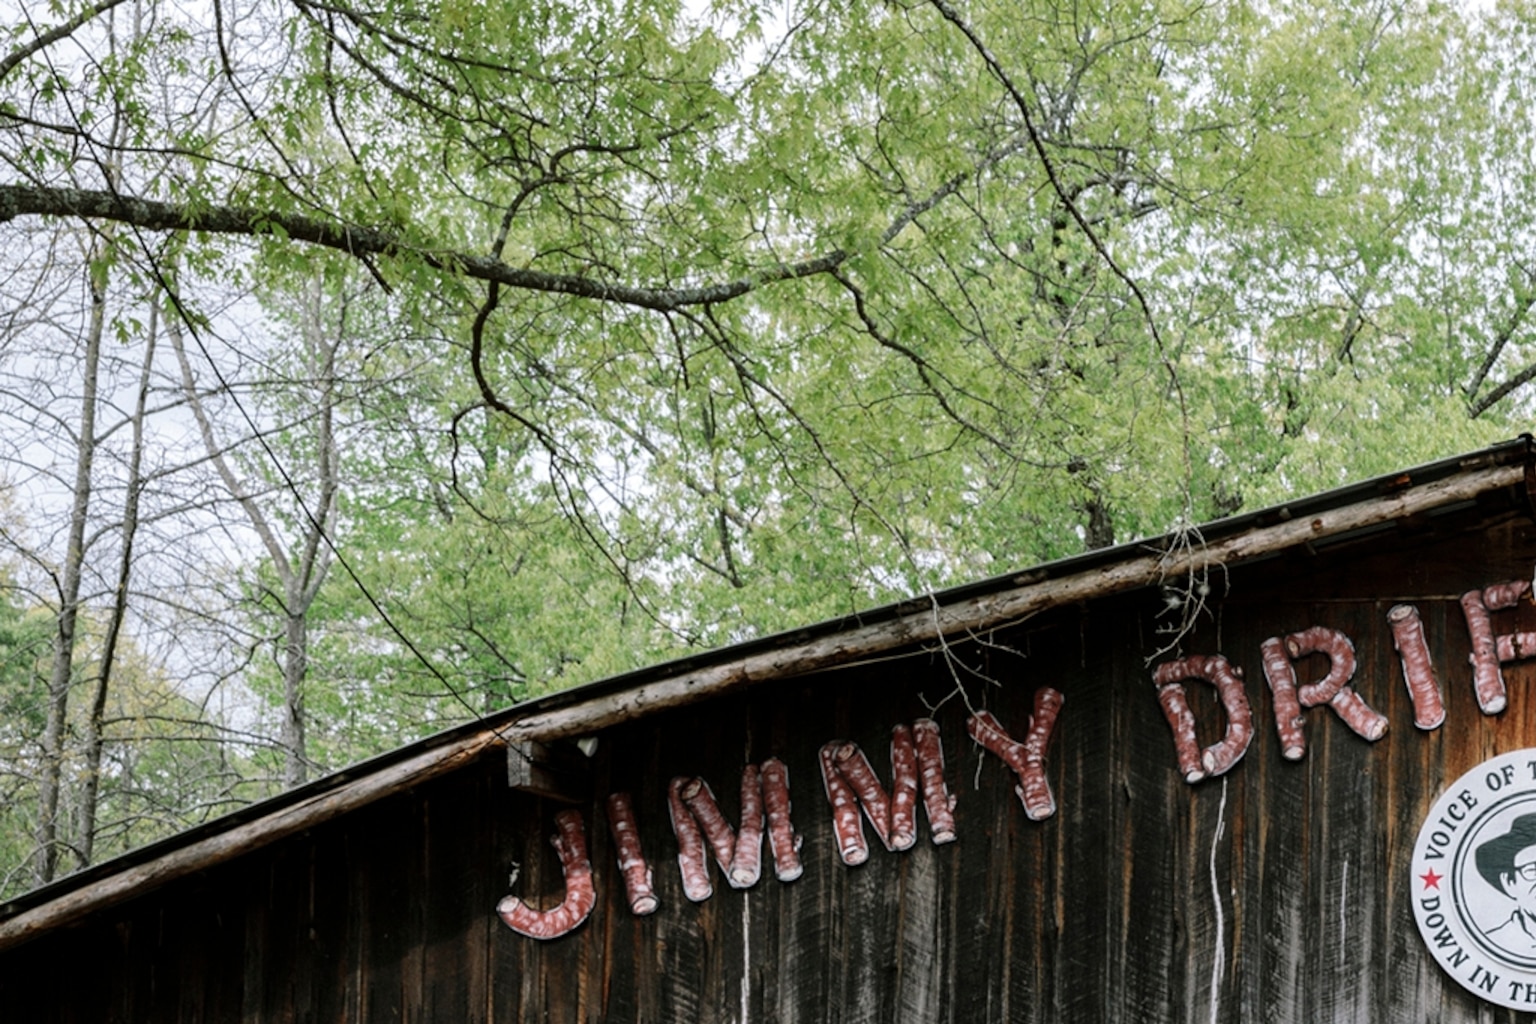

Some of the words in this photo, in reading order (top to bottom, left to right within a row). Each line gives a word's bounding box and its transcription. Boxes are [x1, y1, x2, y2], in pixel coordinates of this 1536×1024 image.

[496, 686, 1065, 940] JIMMY
[1425, 789, 1478, 861] VOICE
[1485, 765, 1515, 792] OF
[1421, 896, 1470, 969] DOWN
[1467, 965, 1500, 993] IN
